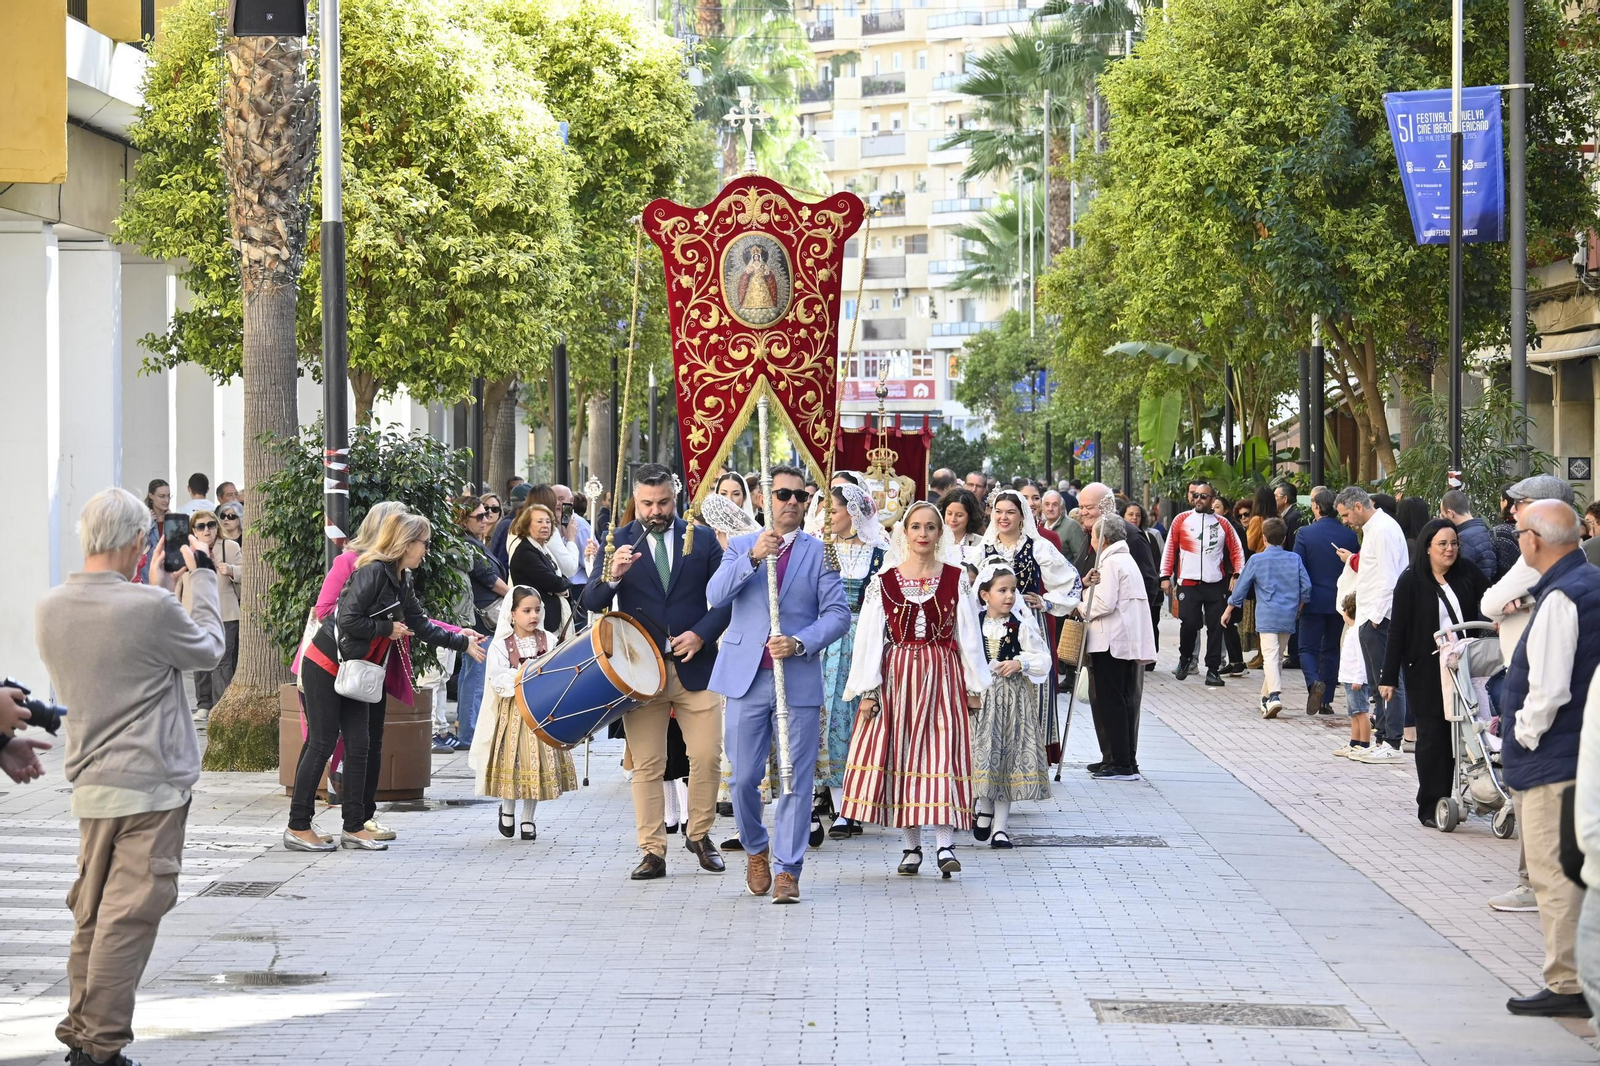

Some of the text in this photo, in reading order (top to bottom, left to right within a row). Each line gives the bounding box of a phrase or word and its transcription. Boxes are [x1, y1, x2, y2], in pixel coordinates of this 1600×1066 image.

[1416, 112, 1447, 124] FESTIVAL
[1397, 114, 1414, 143] 51
[1417, 120, 1489, 135] CINE IBEROERICANO
[1417, 135, 1425, 143] DEL
